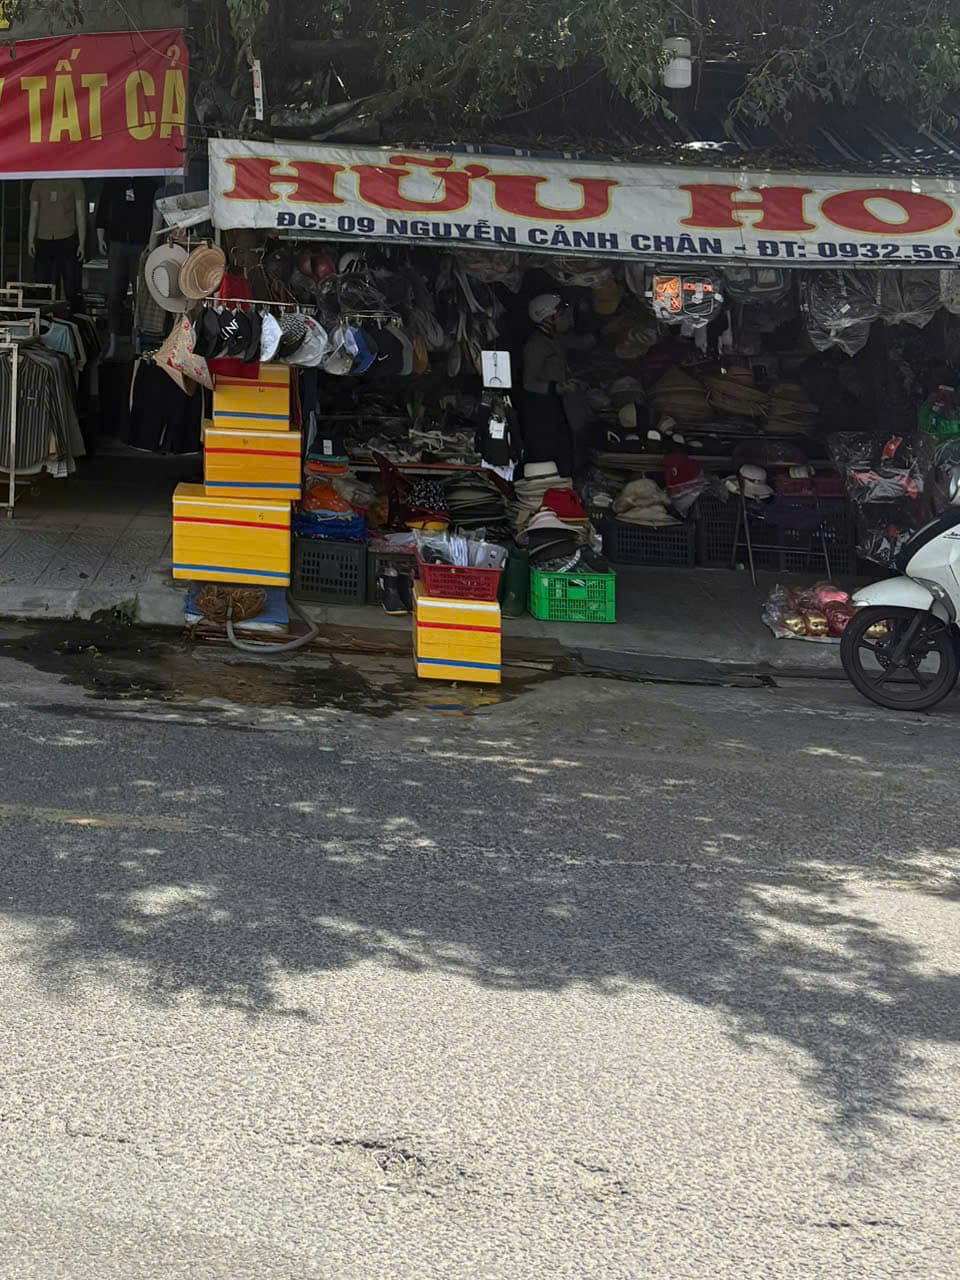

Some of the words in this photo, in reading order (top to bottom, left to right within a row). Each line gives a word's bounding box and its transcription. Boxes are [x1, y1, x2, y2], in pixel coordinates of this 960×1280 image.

[21, 48, 108, 143] TẤT
[125, 45, 186, 141] CẢ
[223, 154, 620, 222] HỮU
[276, 212, 327, 230] ĐC:
[337, 215, 375, 233] 09
[386, 218, 517, 243] NGUYỄN
[528, 223, 619, 250] CẢNH
[630, 231, 723, 255] CHÂN
[757, 240, 807, 258] ĐT:
[817, 242, 960, 261] 0932.56
